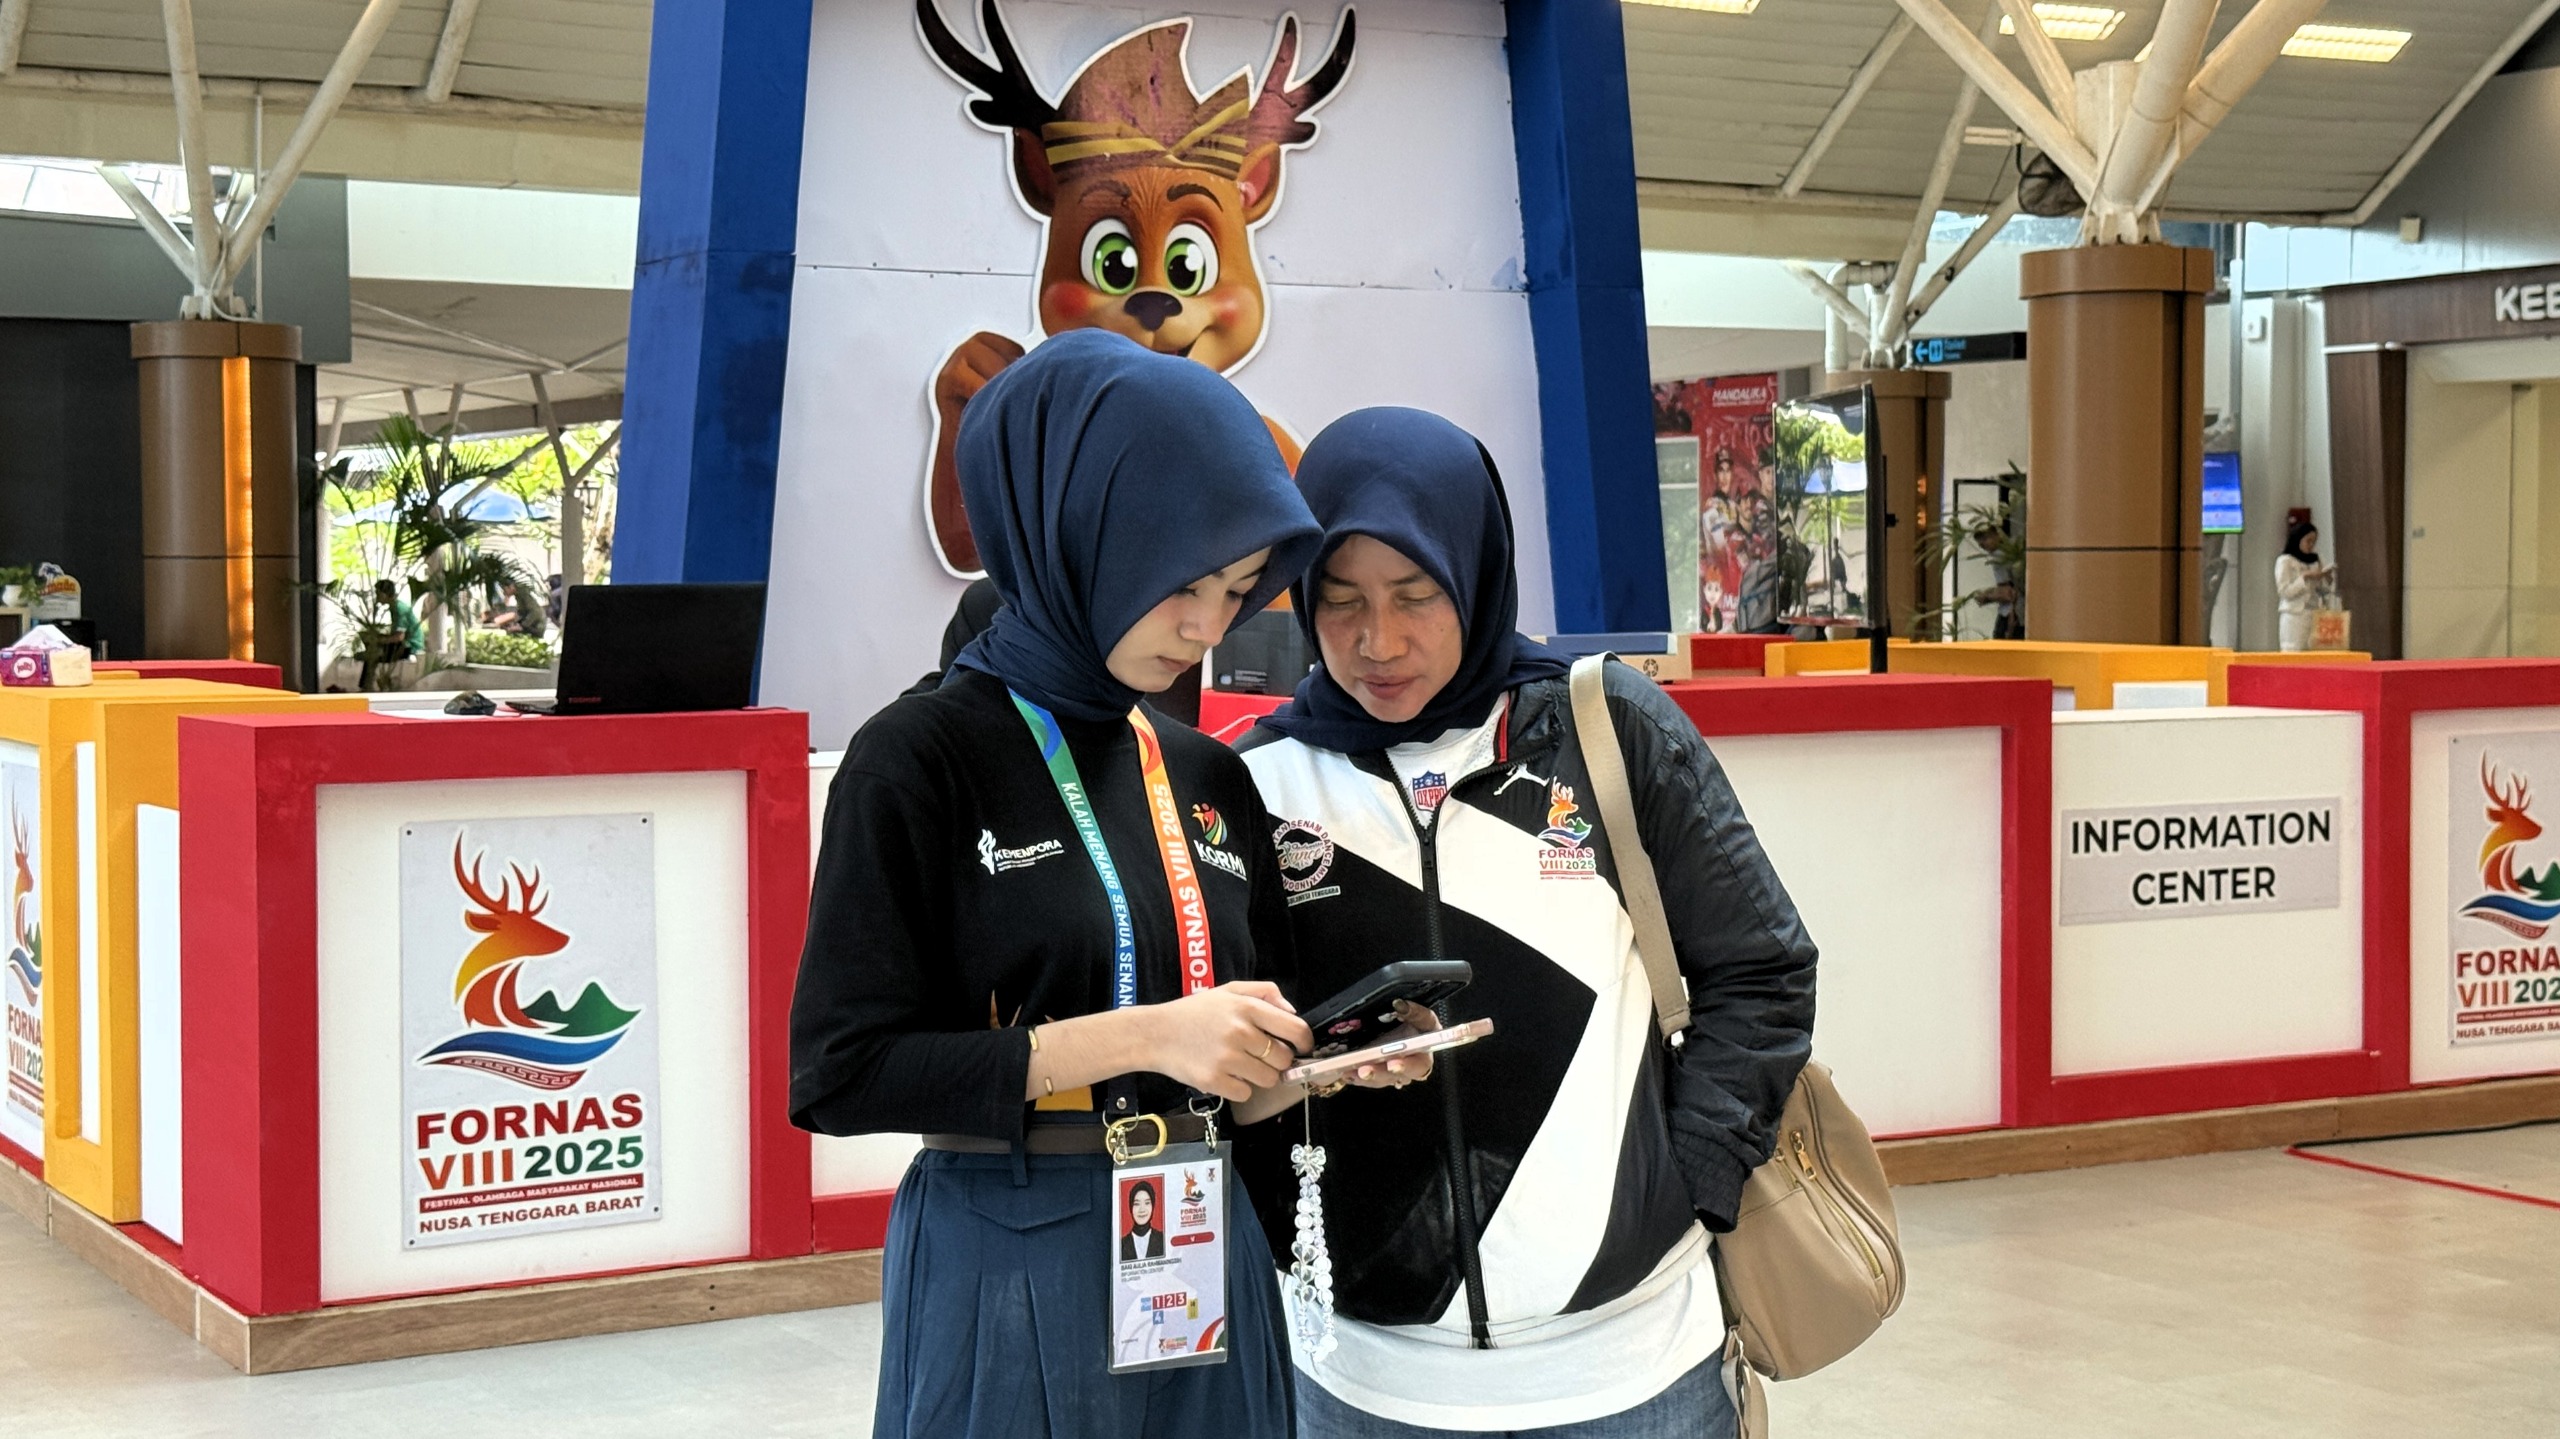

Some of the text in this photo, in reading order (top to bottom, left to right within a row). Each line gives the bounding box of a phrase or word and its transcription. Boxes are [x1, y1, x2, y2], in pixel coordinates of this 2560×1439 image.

[1290, 820, 1323, 833] SENAM
[2072, 810, 2330, 854] INFORMATION
[994, 839, 1063, 861] KEMENPORA
[1321, 832, 1332, 865] DANCE
[1538, 848, 1593, 859] FORNAS
[1311, 866, 1326, 884] MIX
[1539, 860, 1595, 870] VIII 2025
[1061, 782, 1133, 1008] KALAH MENANG SEMUA SENAN
[1153, 783, 1209, 994] FORNAS VIII 2025
[1283, 879, 1310, 890] INDON
[2132, 866, 2275, 906] CENTER
[2457, 946, 2560, 978] FORNA
[2458, 977, 2560, 1008] VIII 202
[8, 1003, 43, 1049] FORNA
[27, 1049, 43, 1083] 202
[417, 1093, 643, 1150] FORNAS
[419, 1135, 644, 1190] VIII 2025
[425, 1178, 639, 1209] FESTIVAL OLAHRAGA MASYARAKAT NASIONAL
[419, 1195, 644, 1233] NUSA TENGGARA BARAT
[1154, 1297, 1161, 1308] 1
[1166, 1295, 1173, 1307] 2
[1177, 1293, 1185, 1305] 3
